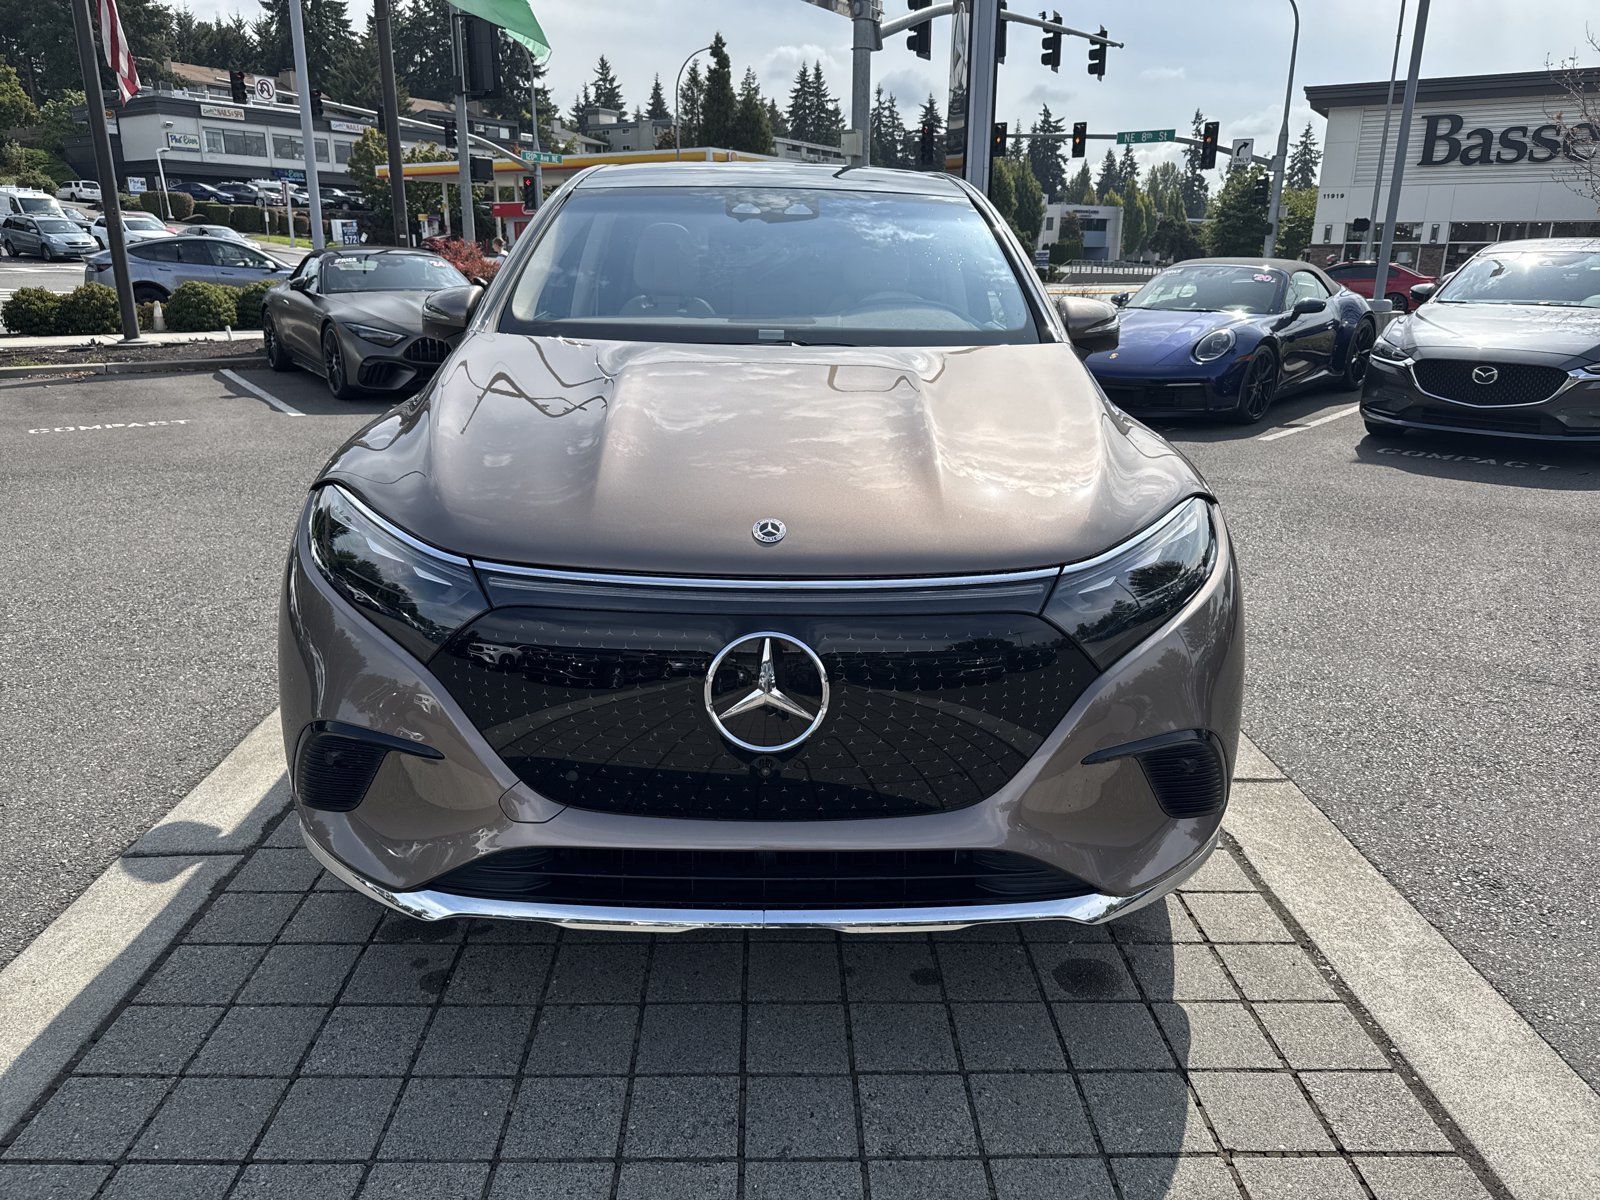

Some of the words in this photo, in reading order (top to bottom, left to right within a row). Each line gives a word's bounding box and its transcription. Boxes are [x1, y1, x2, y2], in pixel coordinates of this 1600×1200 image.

[215, 109, 231, 117] NAILS
[234, 111, 244, 119] SPA
[1124, 132, 1136, 143] NE
[1141, 132, 1153, 142] 8th
[1158, 131, 1168, 141] St
[541, 154, 550, 162] Ave
[28, 419, 191, 434] COMPACT
[1376, 447, 1561, 471] COMPACT
